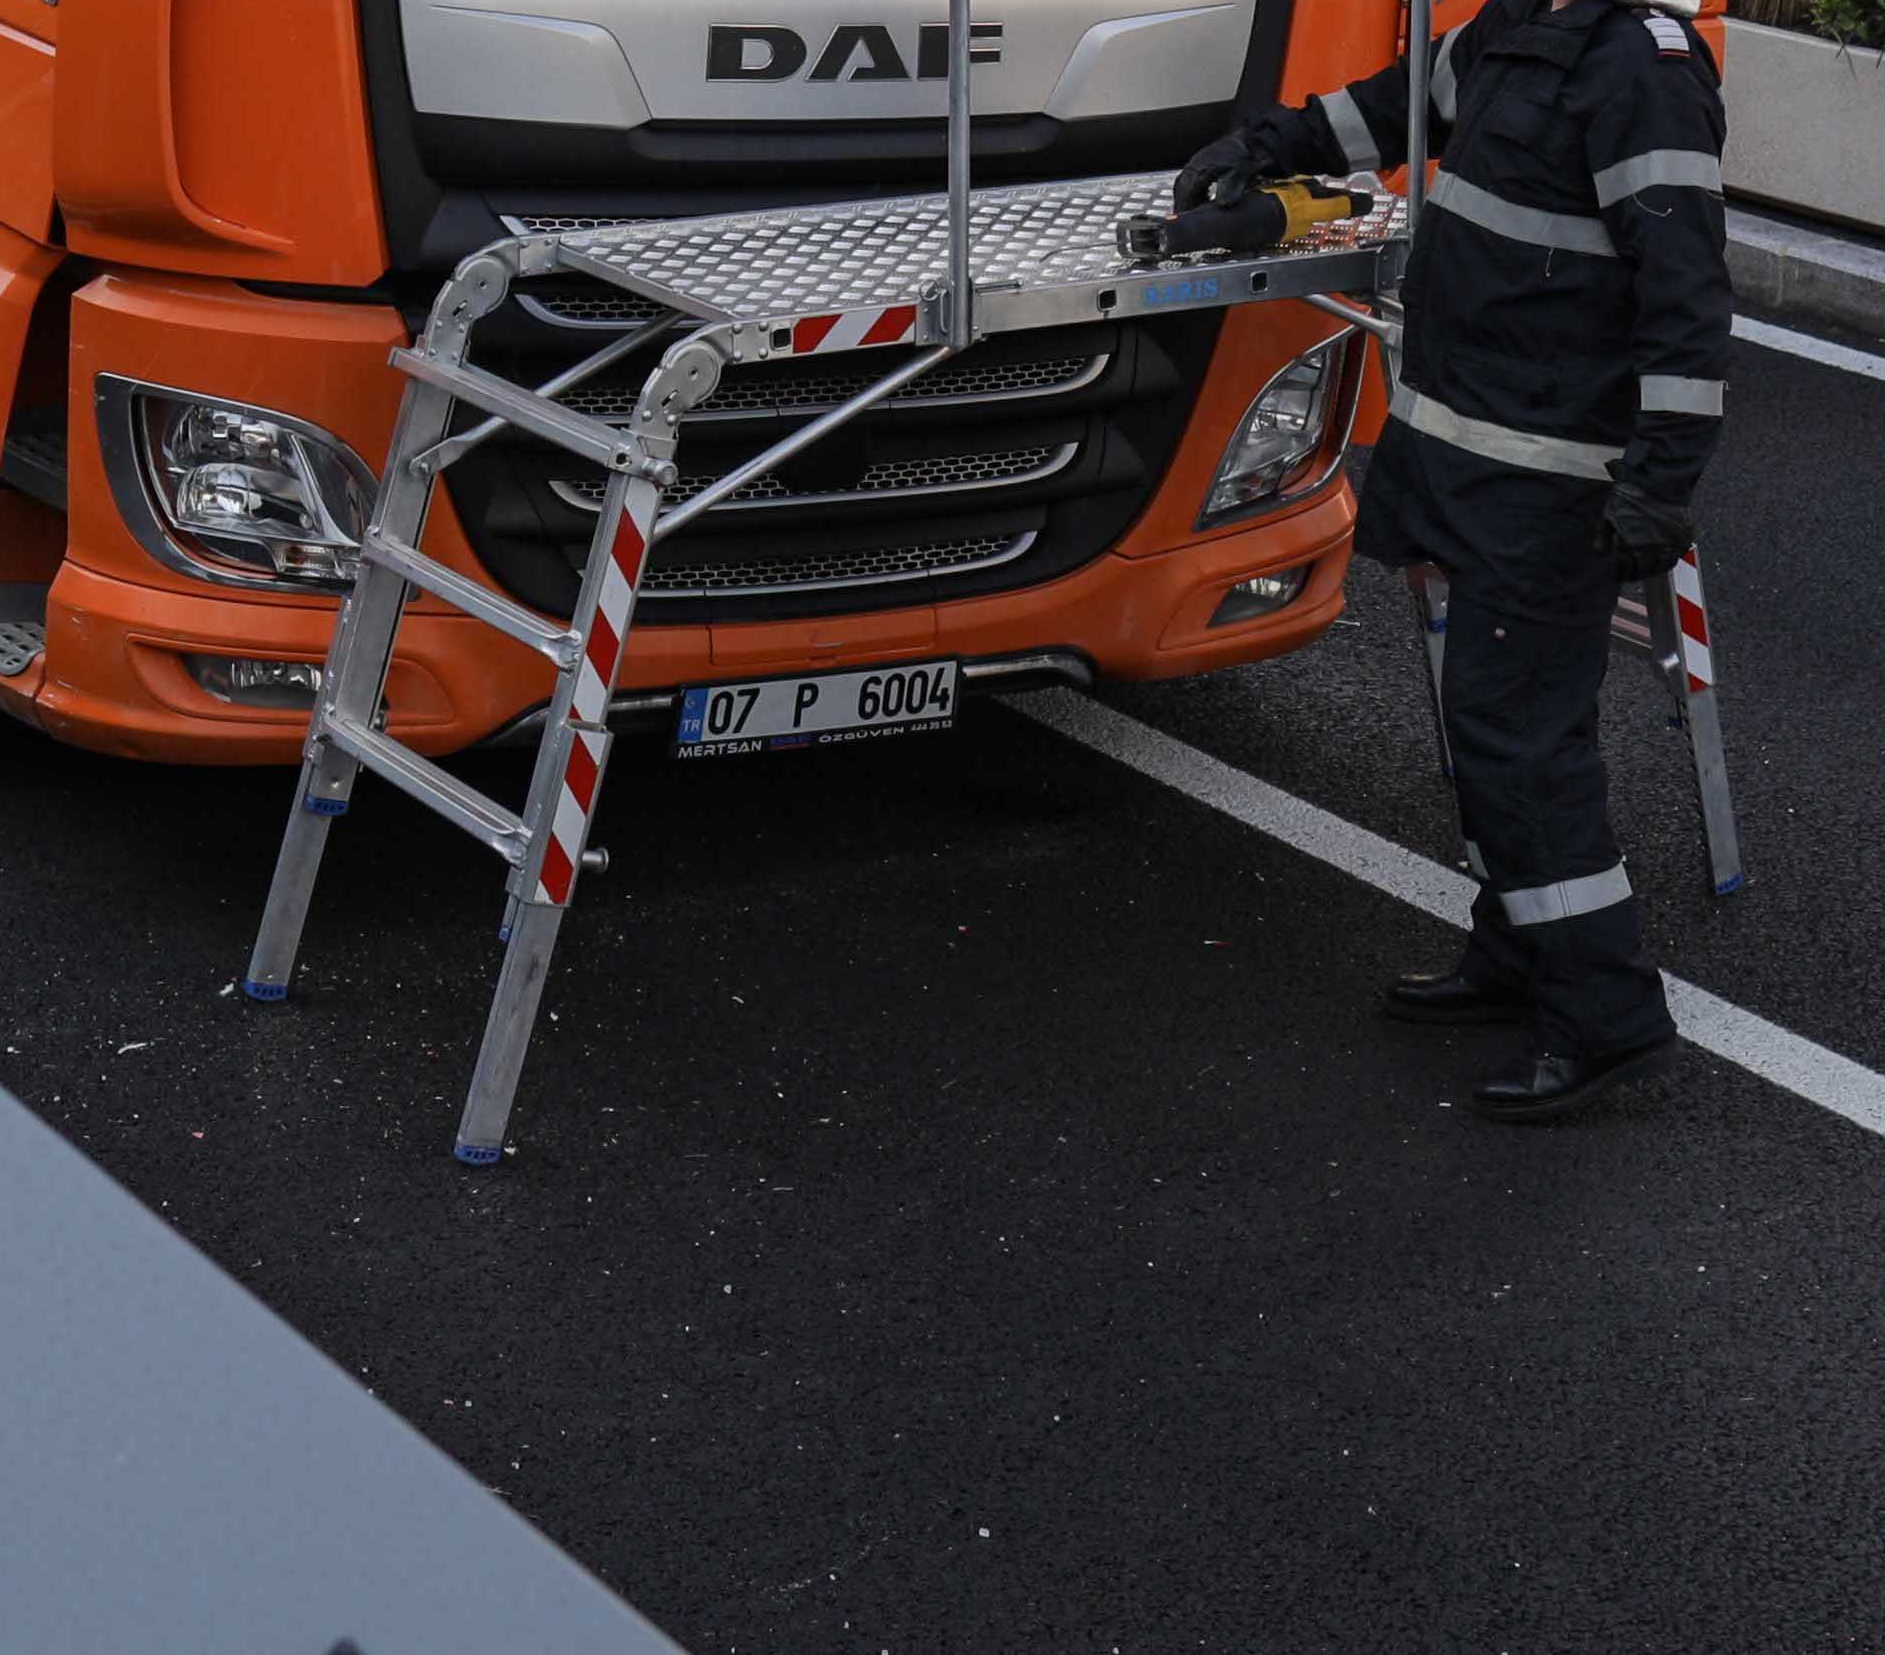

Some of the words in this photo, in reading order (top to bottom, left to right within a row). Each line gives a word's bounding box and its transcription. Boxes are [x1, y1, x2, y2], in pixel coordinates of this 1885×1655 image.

[705, 22, 1004, 83] DAF
[707, 687, 761, 736] 07
[793, 682, 820, 729] P
[857, 667, 951, 721] 6004
[682, 719, 702, 732] TR
[678, 740, 762, 759] MERTSAN
